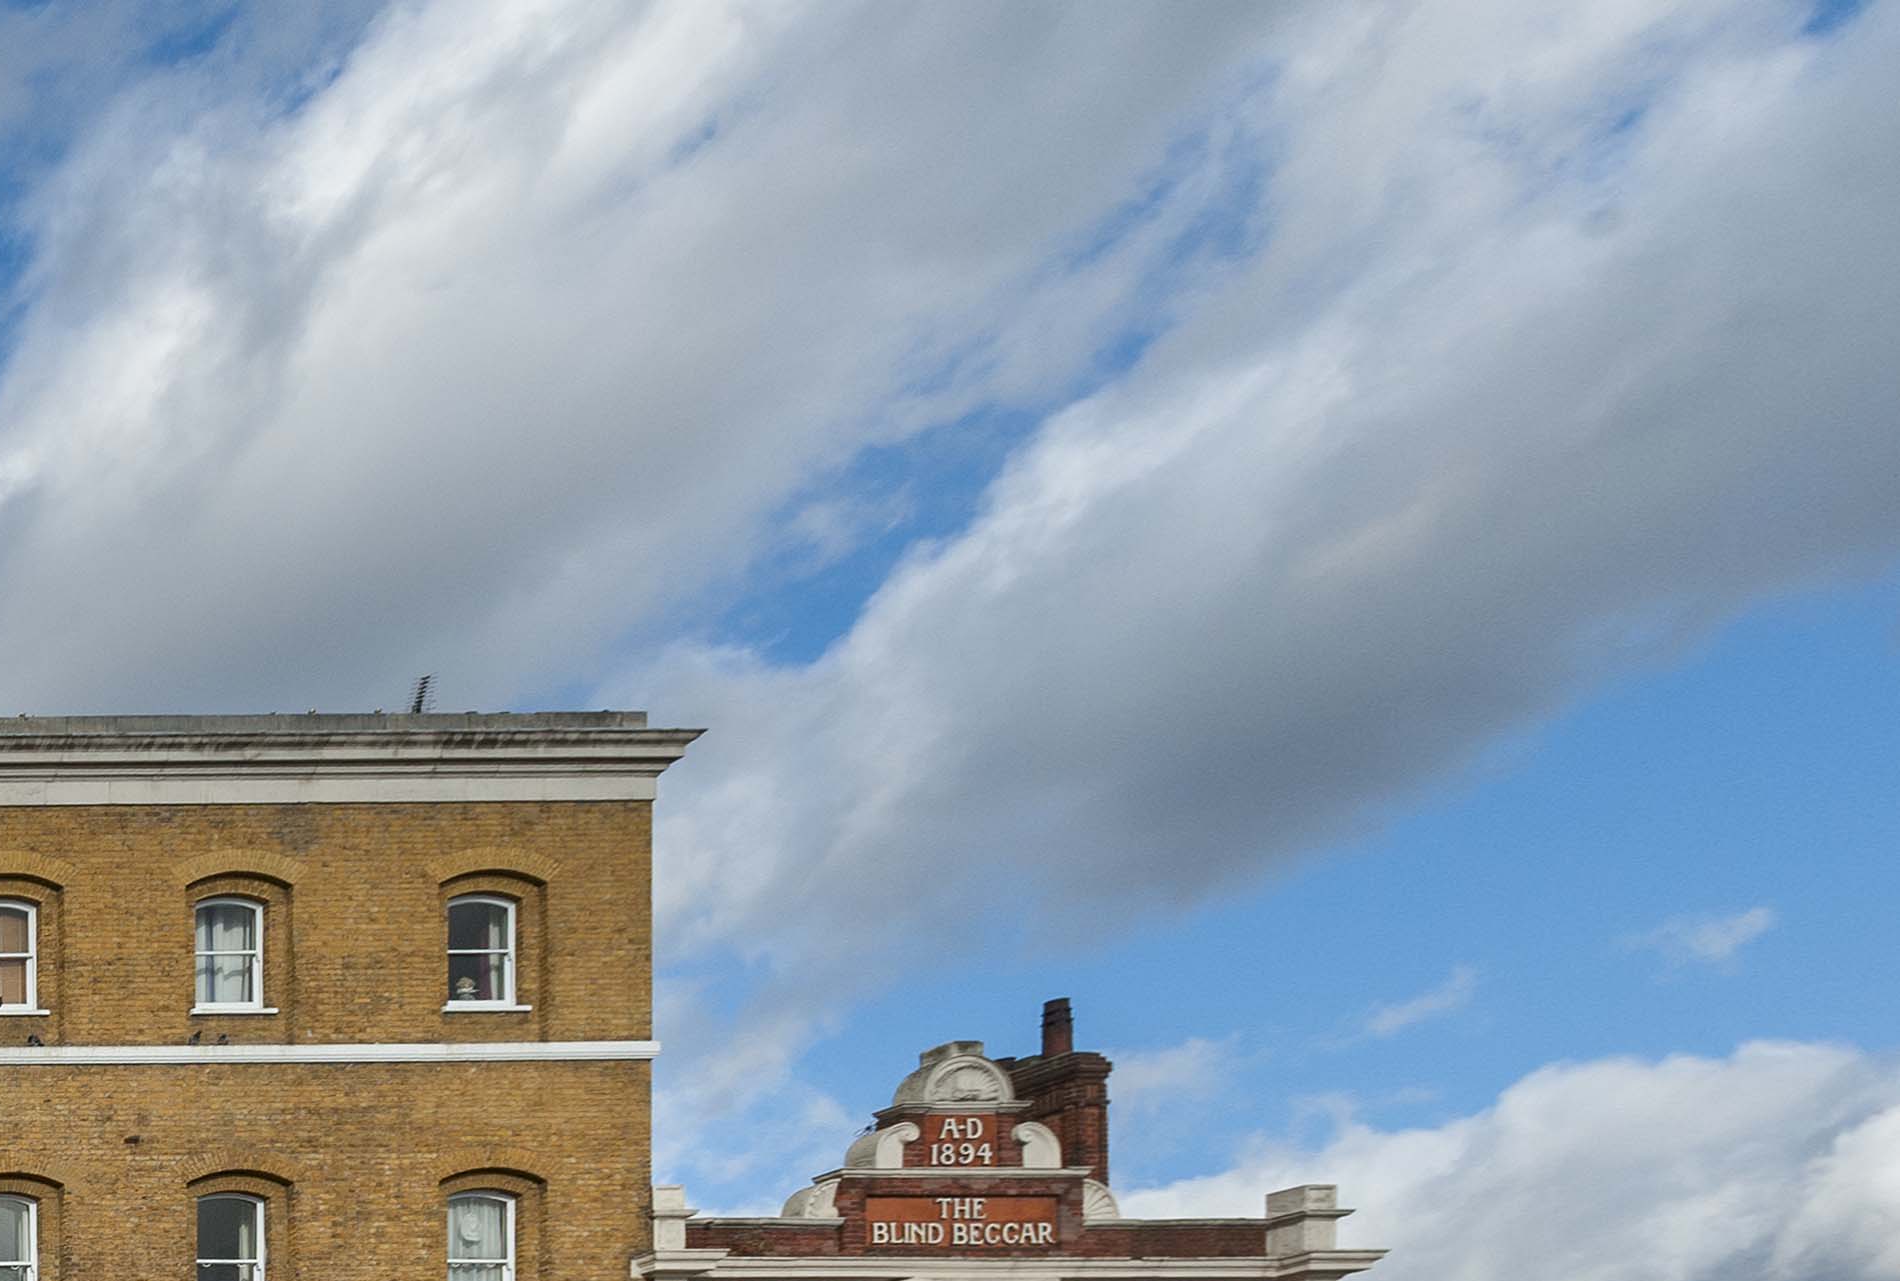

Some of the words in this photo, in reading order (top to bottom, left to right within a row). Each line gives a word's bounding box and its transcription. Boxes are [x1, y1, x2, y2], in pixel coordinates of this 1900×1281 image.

[930, 1143, 993, 1166] 1894
[935, 1197, 987, 1219] THE
[872, 1222, 944, 1244] BLIND
[952, 1223, 1056, 1245] BEGGAR
